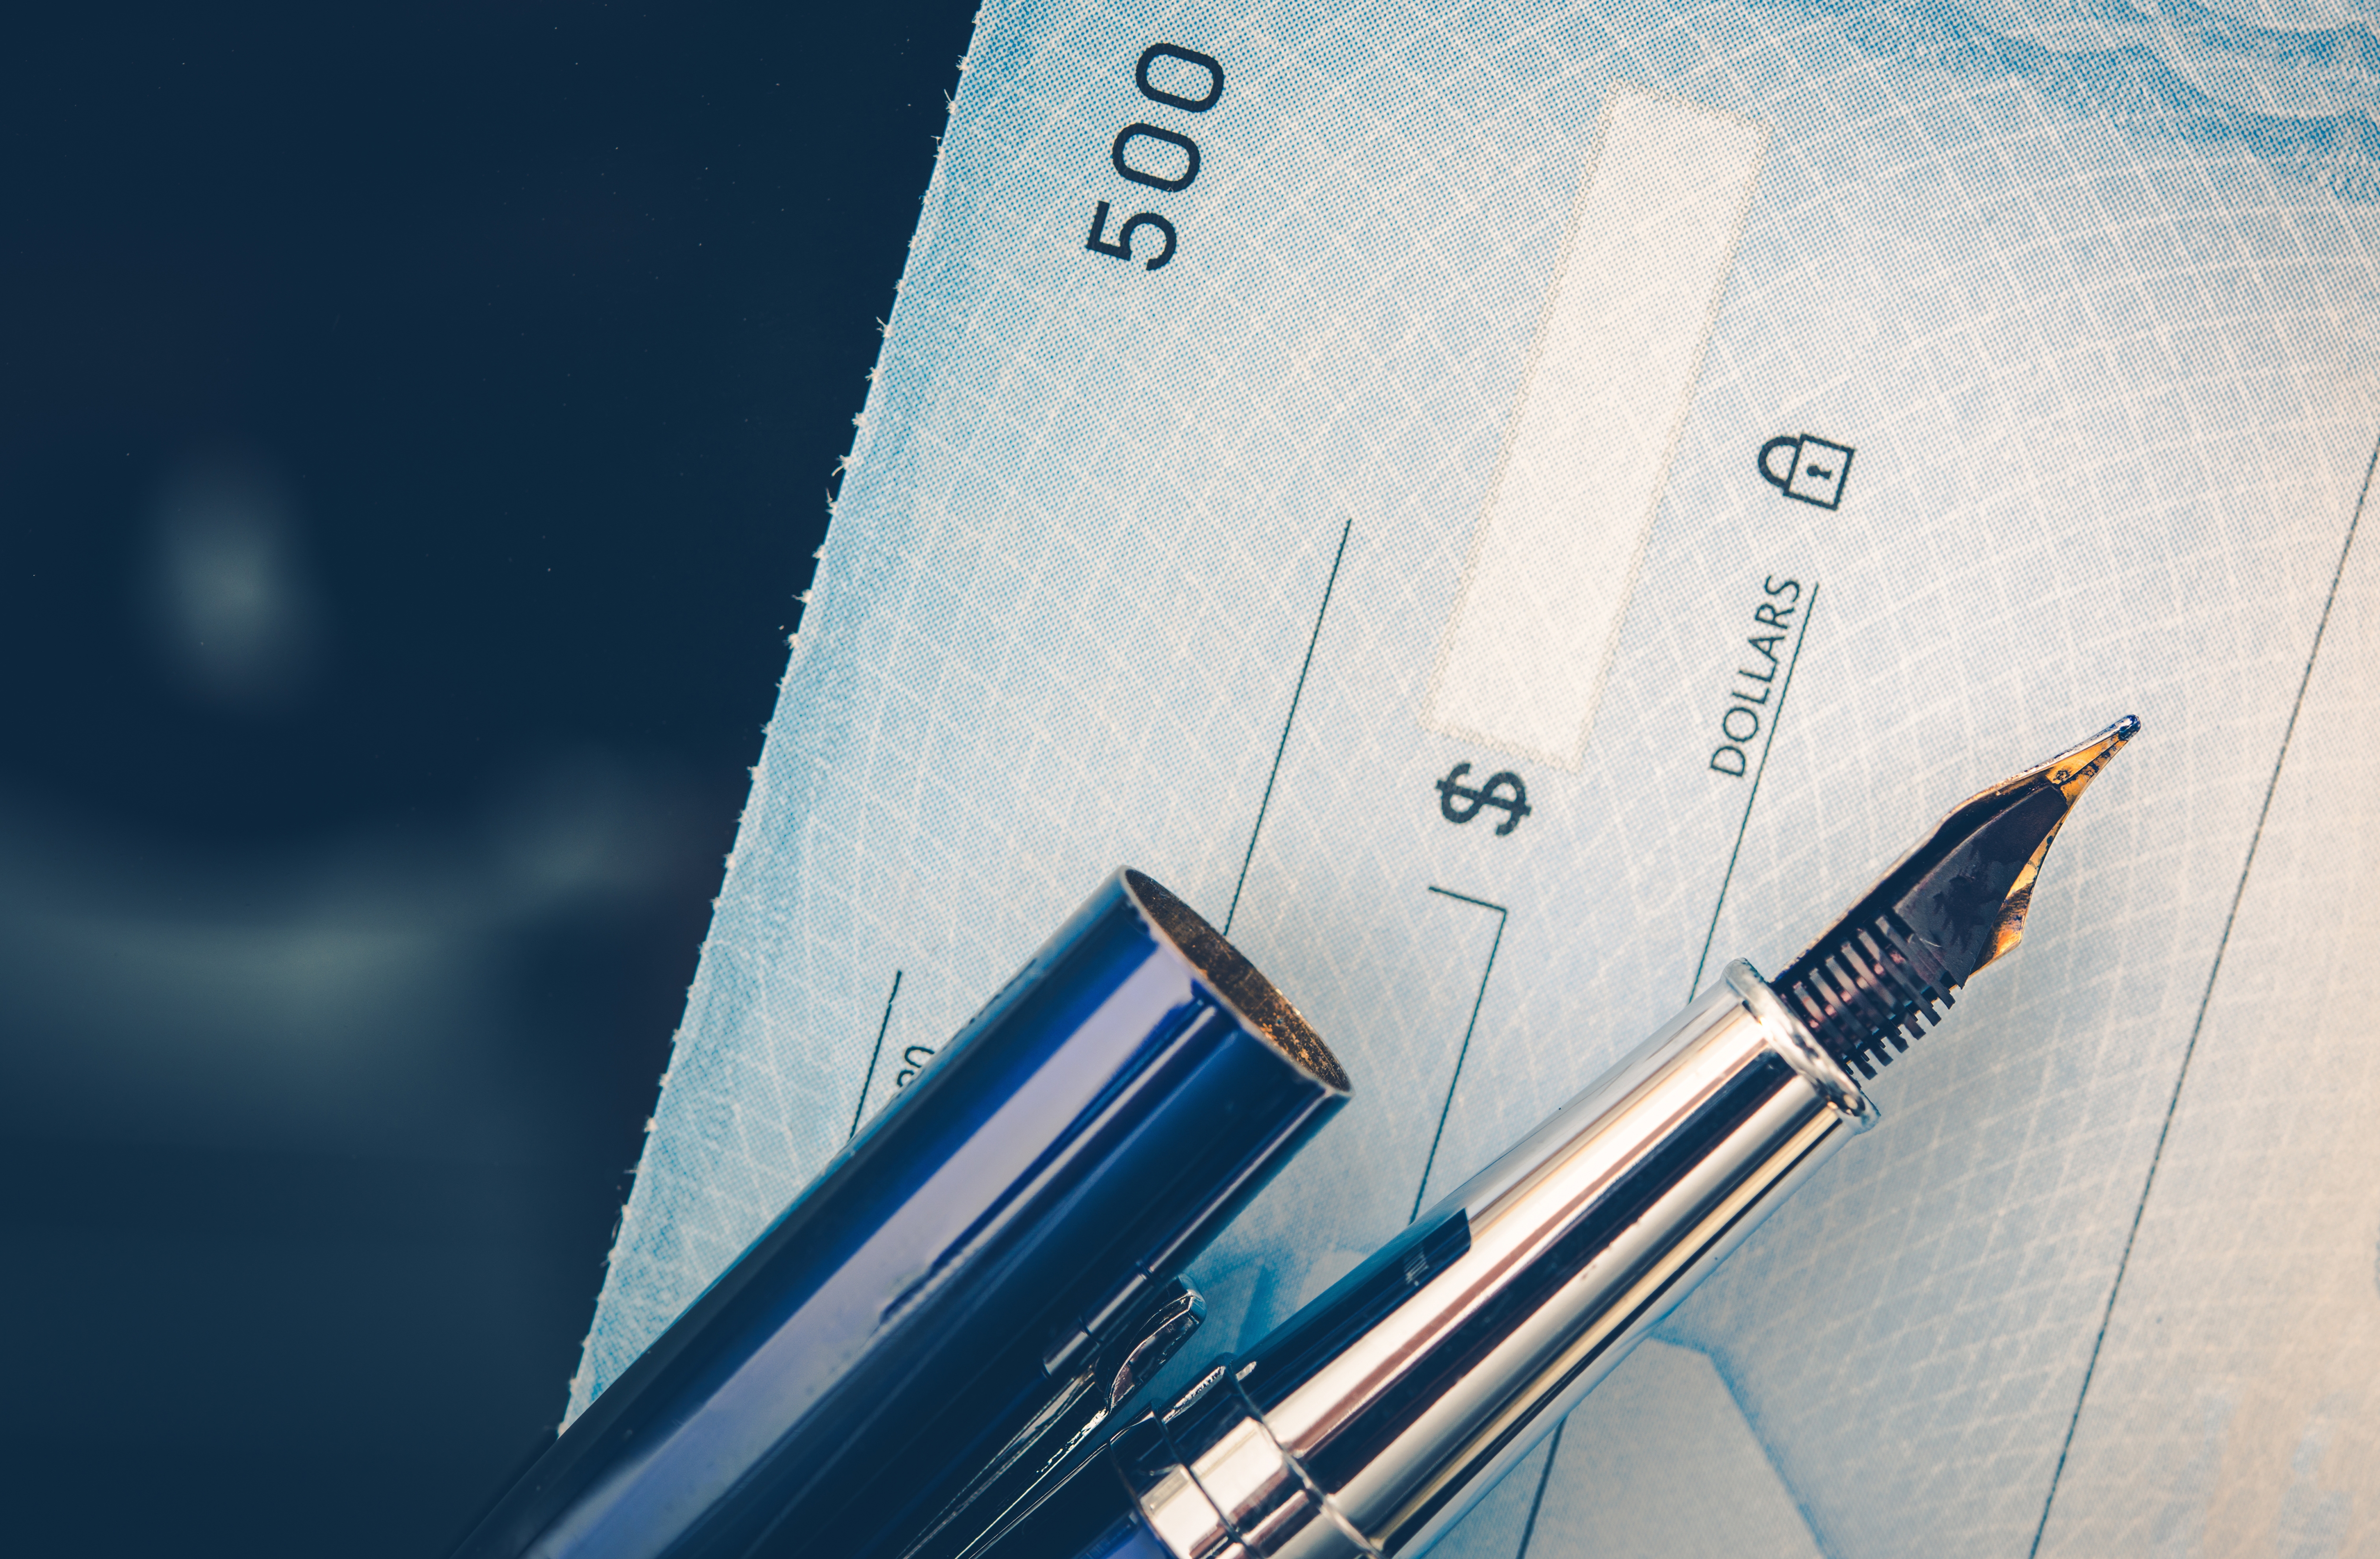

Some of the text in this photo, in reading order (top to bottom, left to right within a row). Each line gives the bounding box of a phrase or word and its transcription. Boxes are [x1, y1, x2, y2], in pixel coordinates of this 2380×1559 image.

[1086, 43, 1225, 271] 500
[1710, 575, 1801, 778] DOLLARS
[1436, 763, 1532, 836] $
